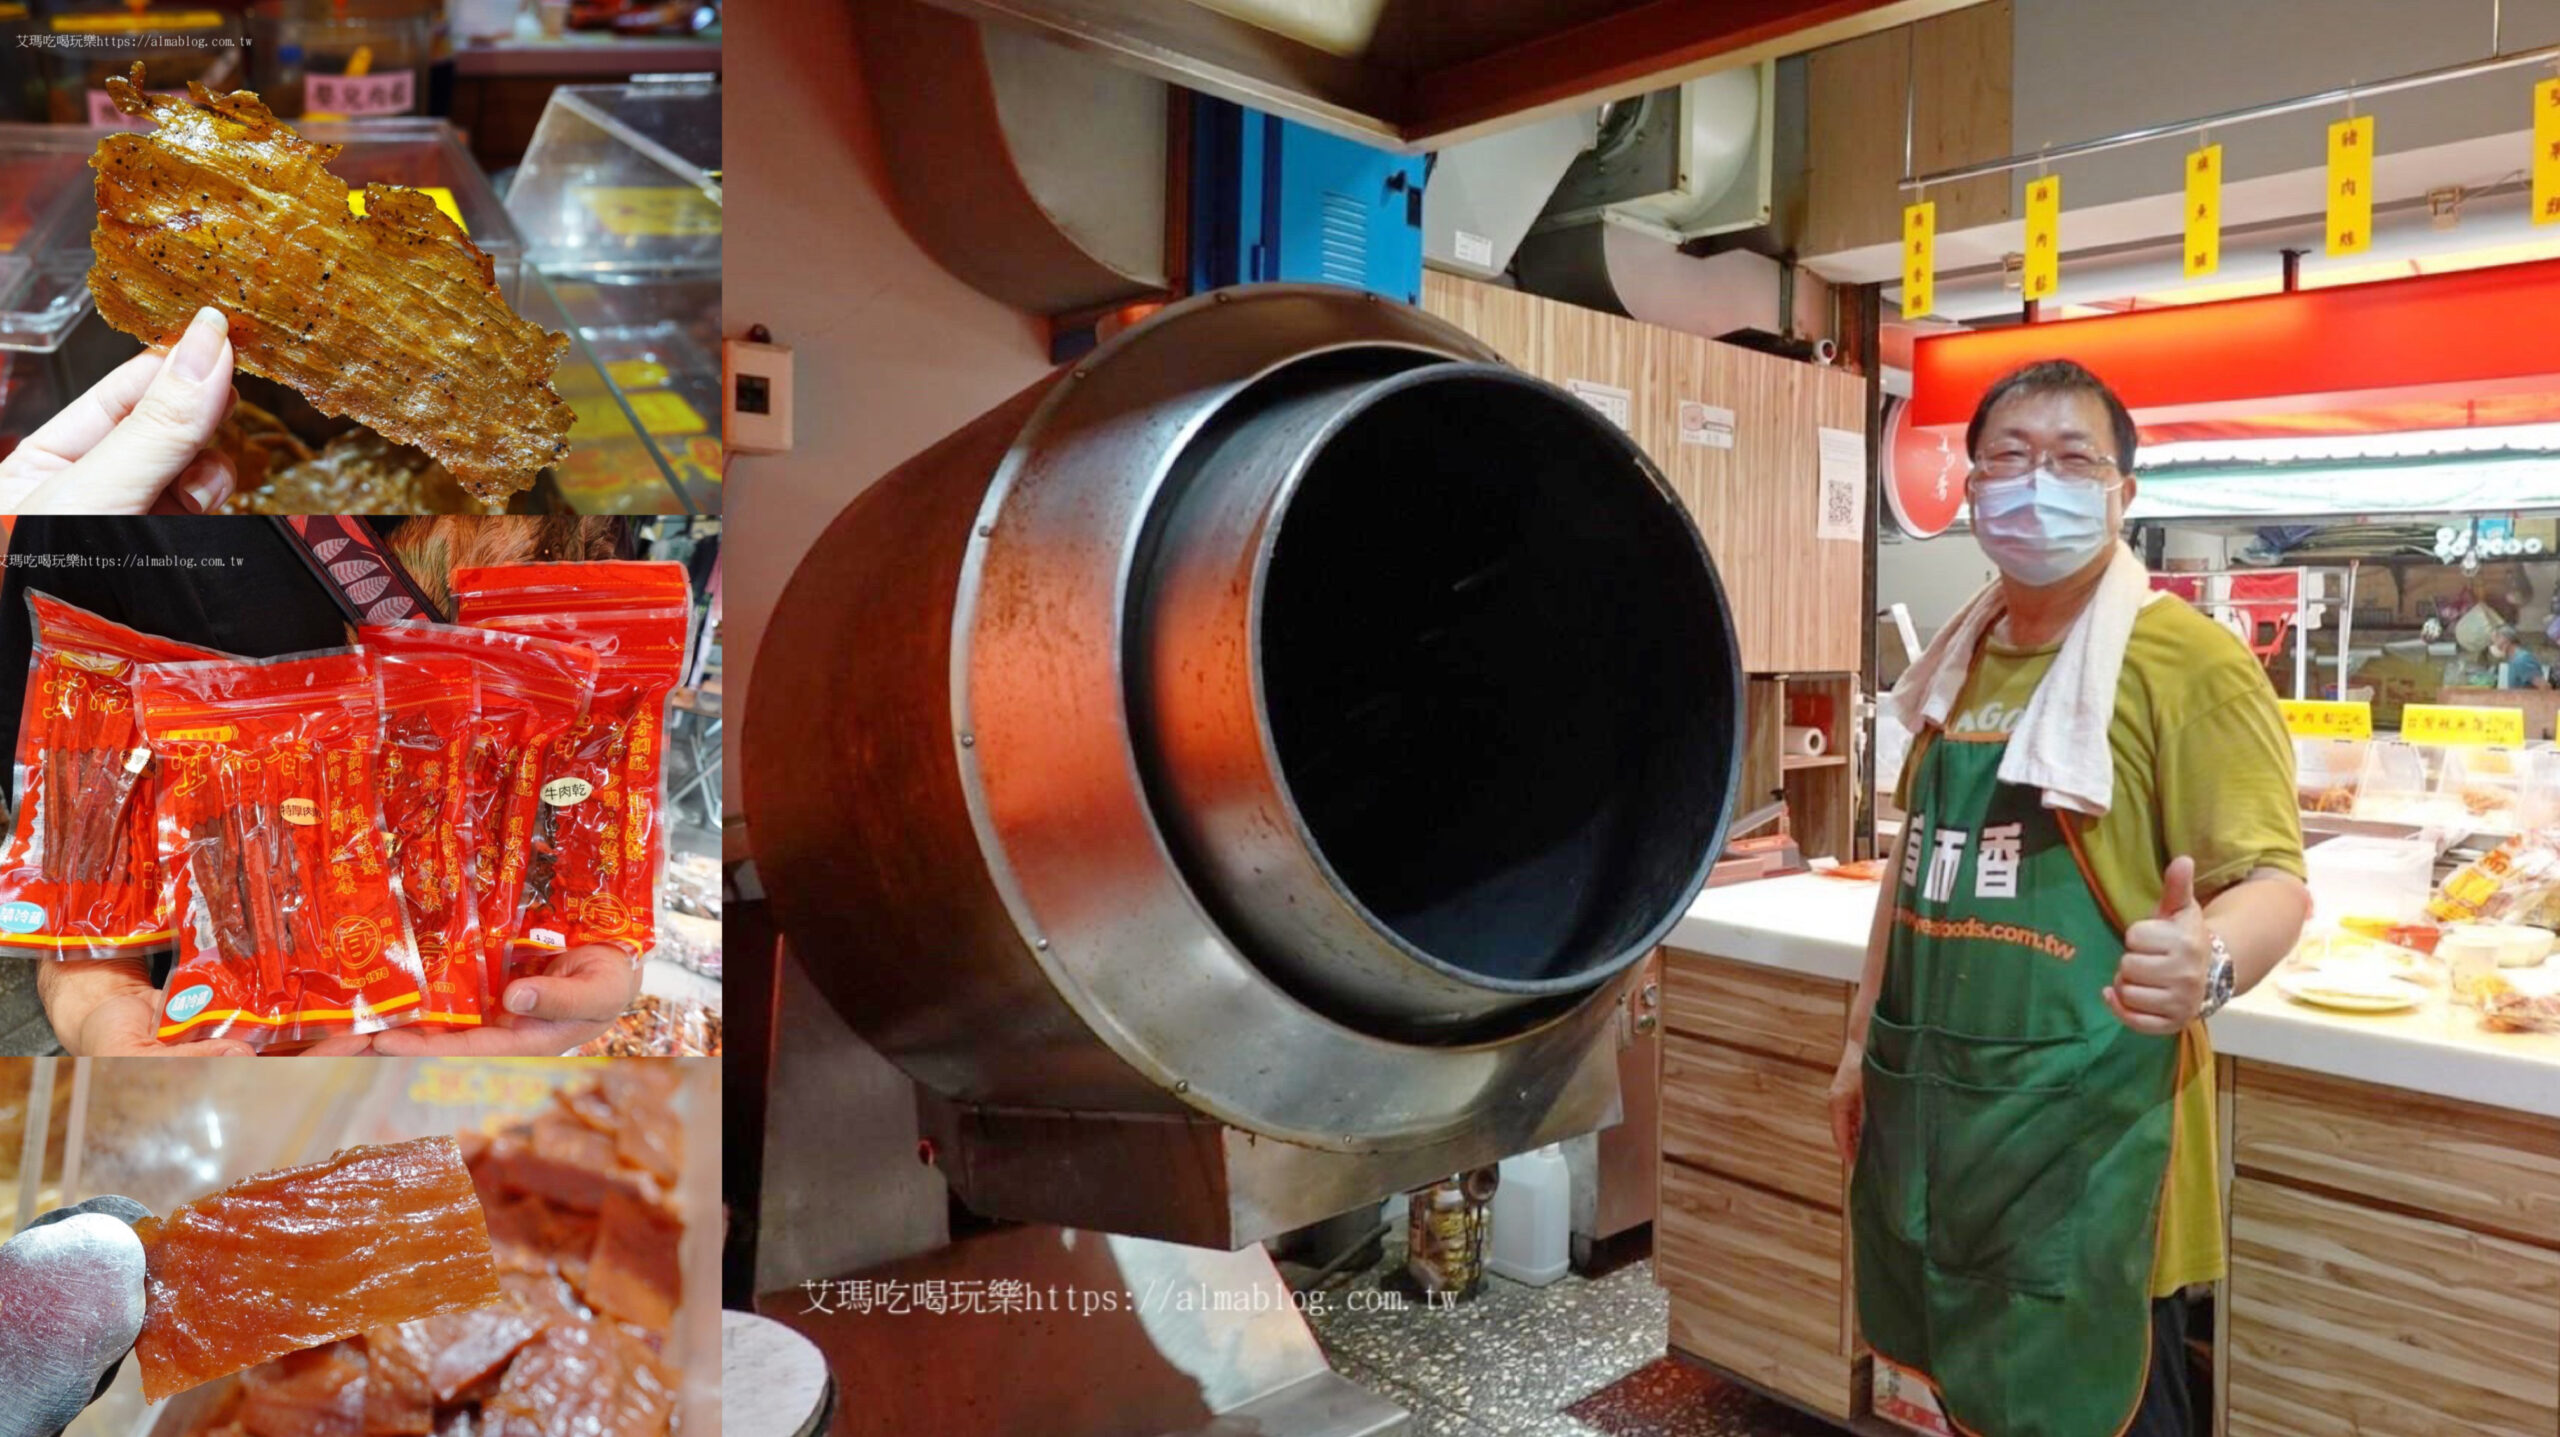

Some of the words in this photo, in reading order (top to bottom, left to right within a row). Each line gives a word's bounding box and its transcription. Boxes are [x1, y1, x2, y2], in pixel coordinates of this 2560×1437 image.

[544, 783, 588, 801] 牛肉乾
[366, 967, 390, 984] 1978
